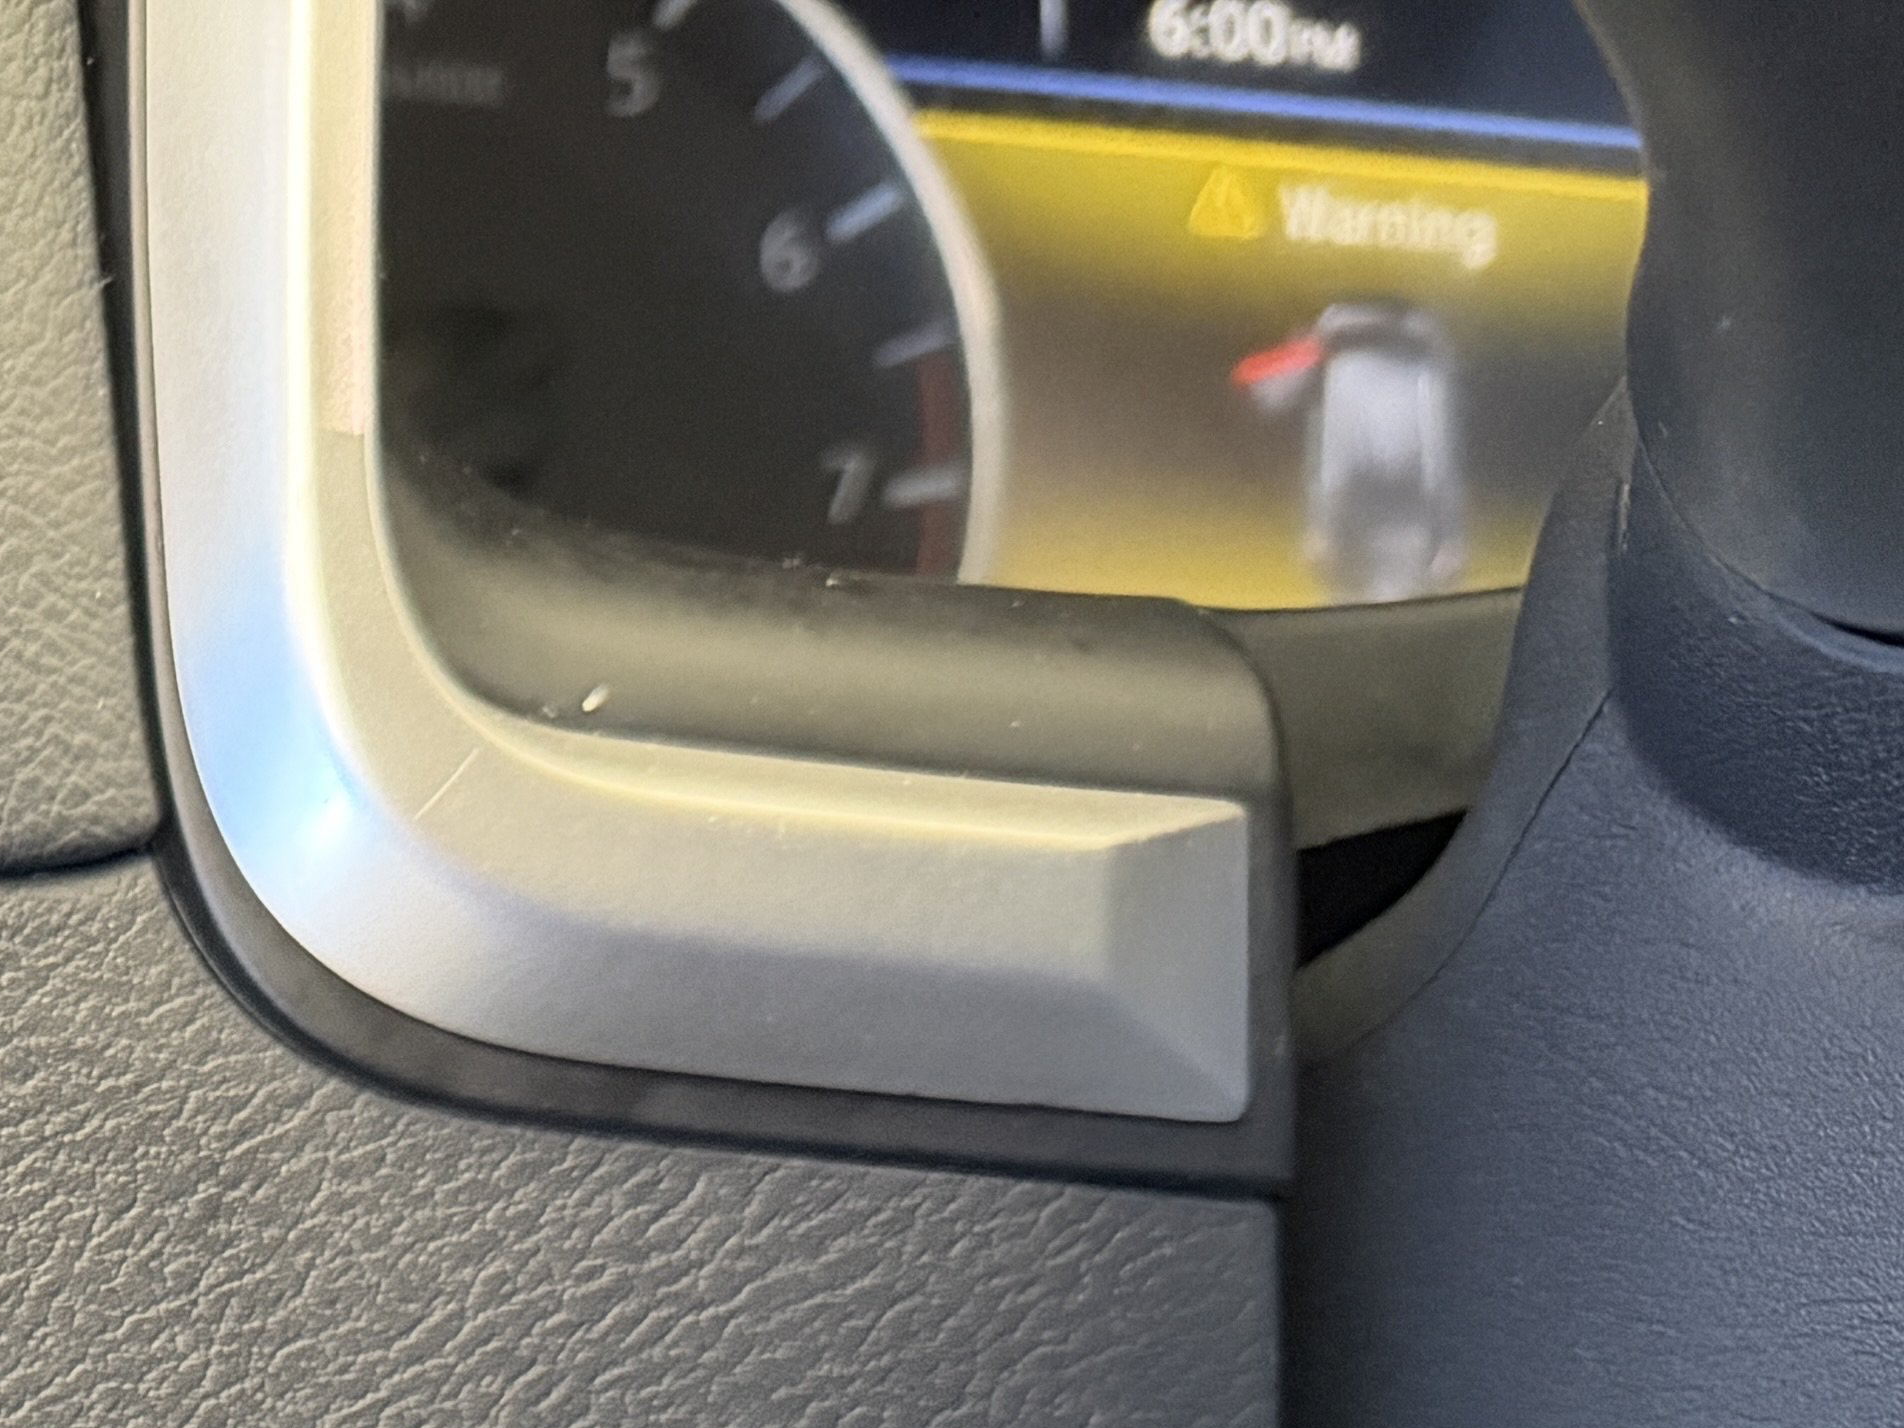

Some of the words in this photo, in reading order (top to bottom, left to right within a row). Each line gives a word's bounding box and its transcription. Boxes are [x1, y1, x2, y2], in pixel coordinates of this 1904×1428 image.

[759, 210, 821, 293] 6
[1280, 182, 1498, 270] Warning
[822, 446, 878, 525] 7
